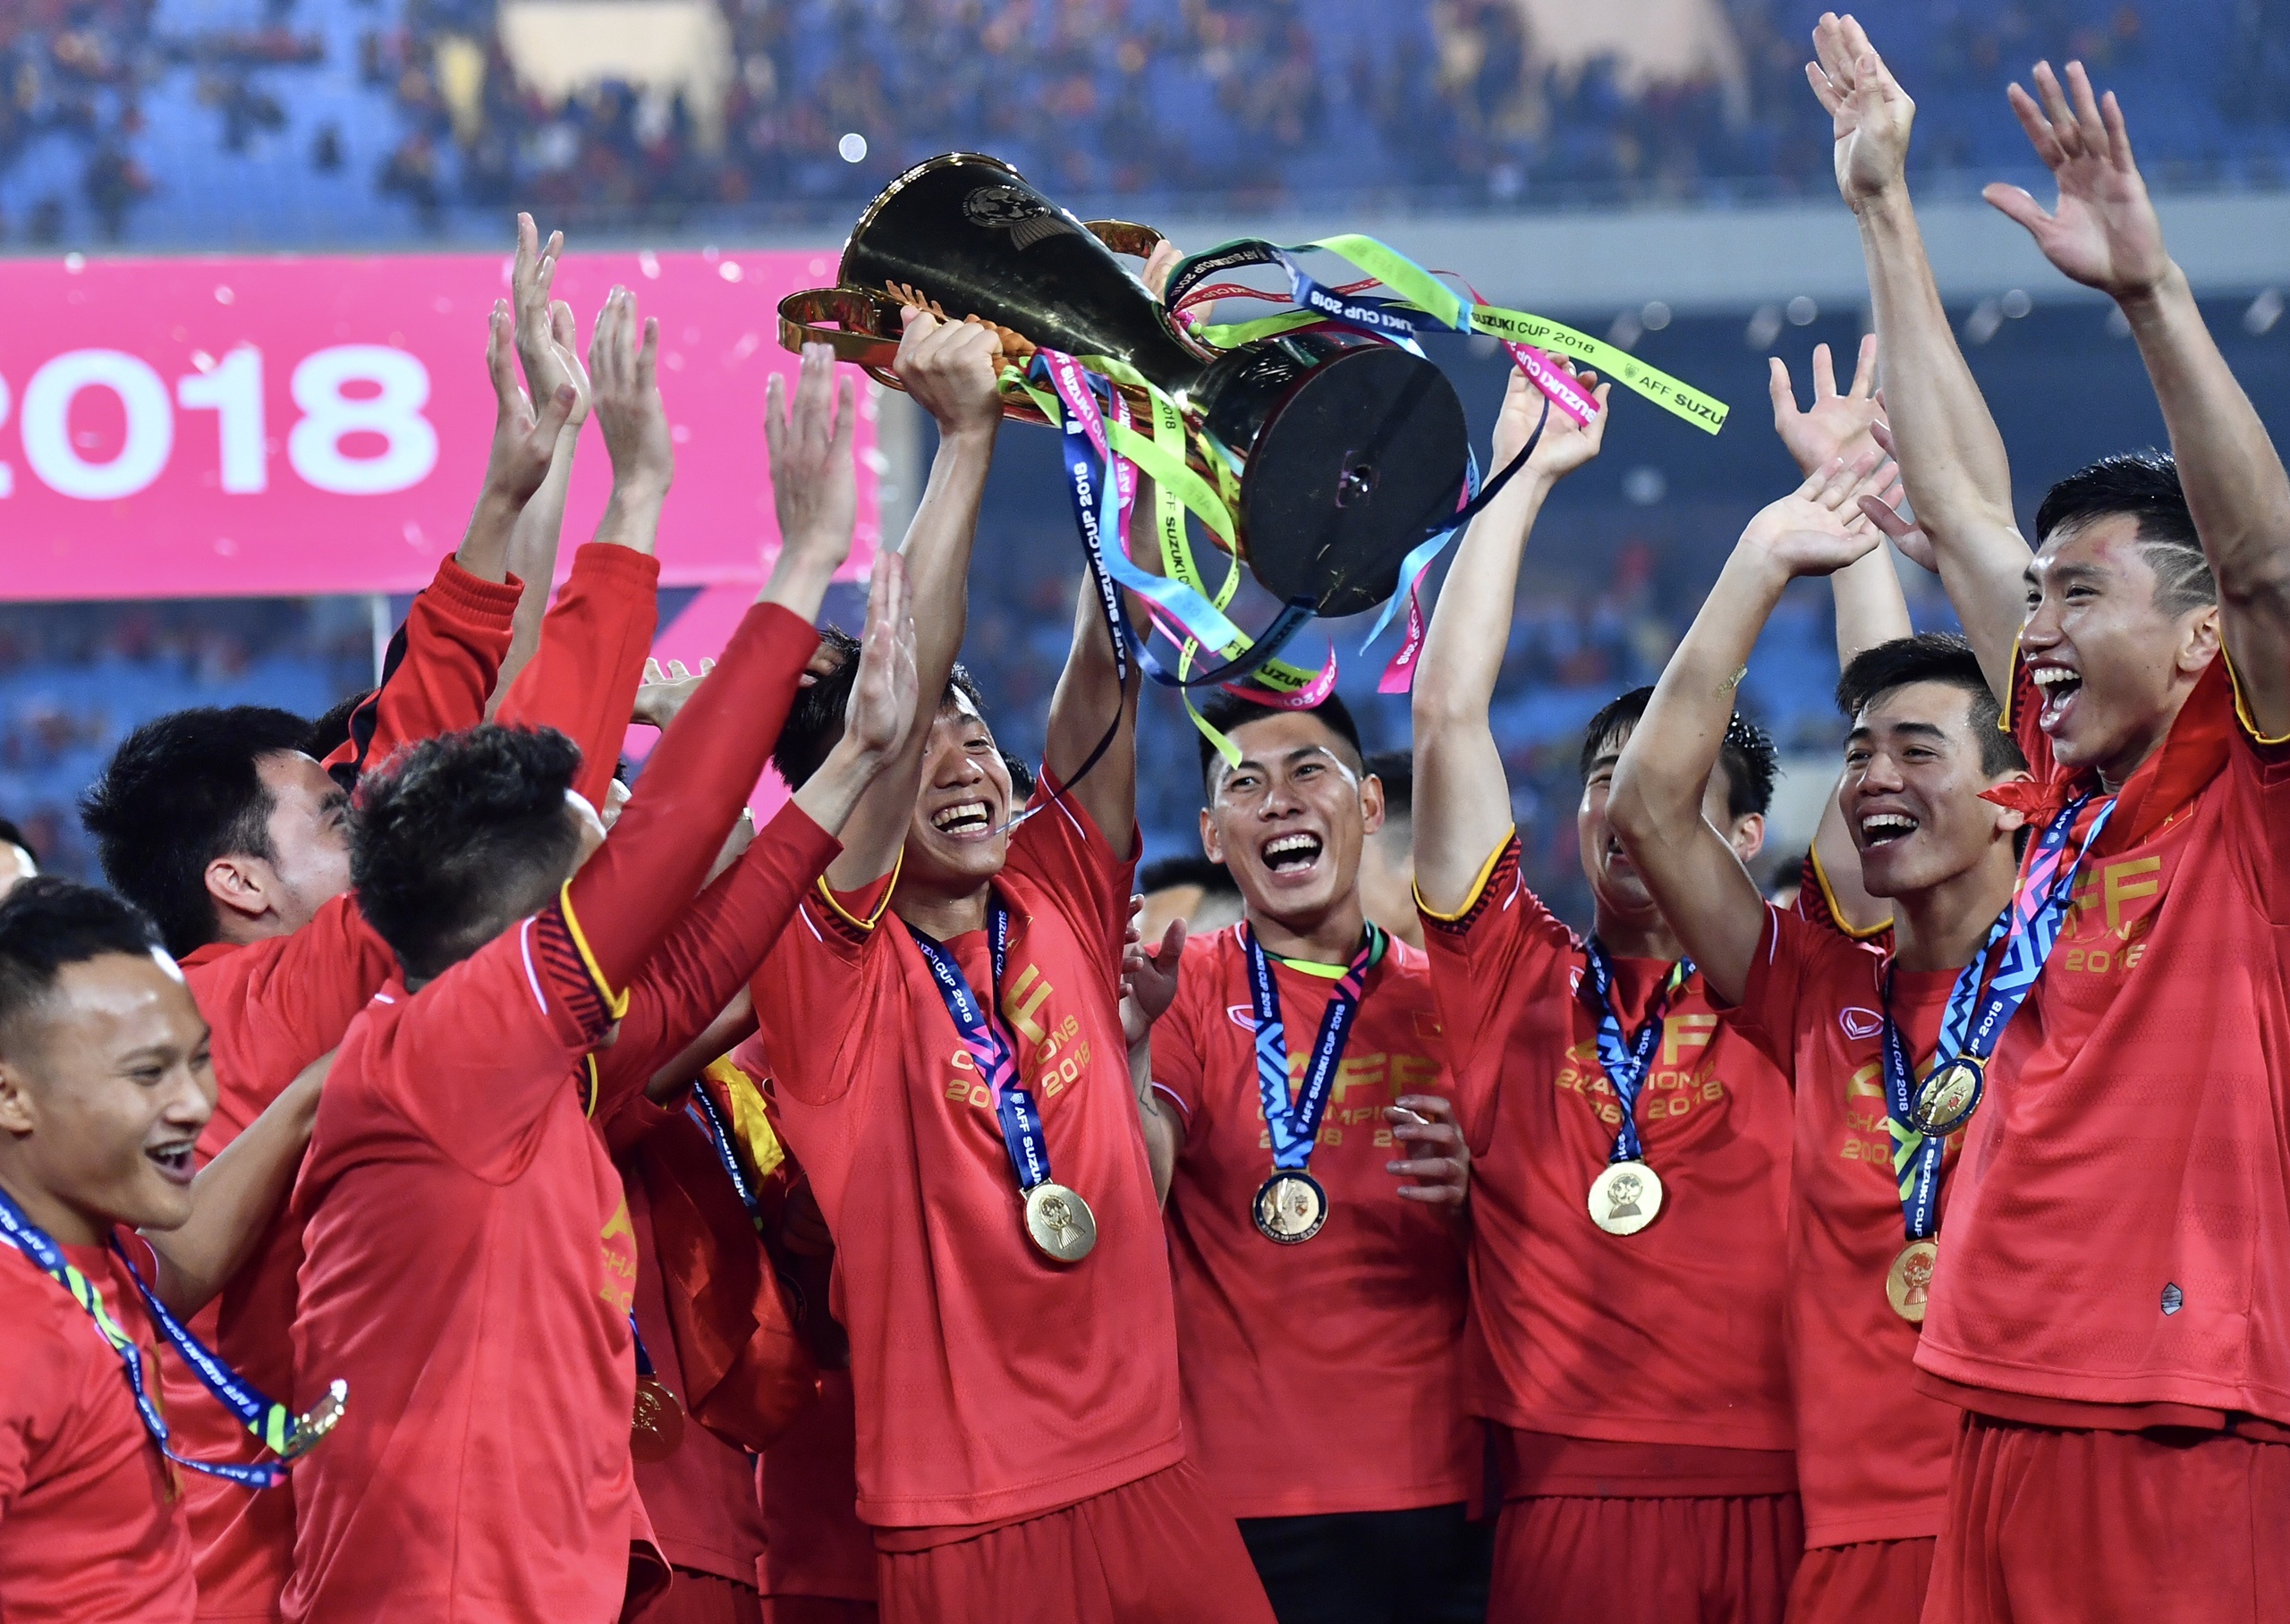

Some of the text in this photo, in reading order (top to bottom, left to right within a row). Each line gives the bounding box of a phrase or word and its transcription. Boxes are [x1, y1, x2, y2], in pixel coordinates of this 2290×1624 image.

[1310, 290, 1344, 315] 2018
[1344, 305, 1381, 324] CUP
[1380, 314, 1415, 334] UKI
[1472, 311, 1595, 354] SUZUKI CUP 2018
[1060, 365, 1095, 421] SUZUKI
[1515, 350, 1598, 424] SUZUKI CUP
[1638, 376, 1726, 426] AFF SUZU
[0, 343, 440, 502] 018
[1116, 461, 1131, 493] AFF
[1165, 488, 1177, 512] FF
[1073, 461, 1126, 661] AFF SUZUKI CUP 2018
[1166, 516, 1186, 578] SUZUKI
[1260, 664, 1311, 689] UZUK
[997, 909, 1007, 952] SUZUKI
[934, 961, 956, 987] CUP
[951, 988, 973, 1024] 2018
[1258, 970, 1269, 992] CUP
[1260, 991, 1273, 1019] 2018
[1978, 1000, 2004, 1037] 2018
[1637, 1028, 1652, 1056] 2018
[1041, 1040, 1091, 1100] 2018
[1301, 1003, 1346, 1125] AFF SUZUKI CUP 2018
[1890, 1020, 1909, 1112] UKI CUP 2018
[1014, 1106, 1030, 1133] AFF
[1647, 1079, 1724, 1120] 2018
[1840, 1138, 1895, 1166] 200
[1917, 1147, 1935, 1205] SUZUKI
[1913, 1205, 1924, 1238] CUP
